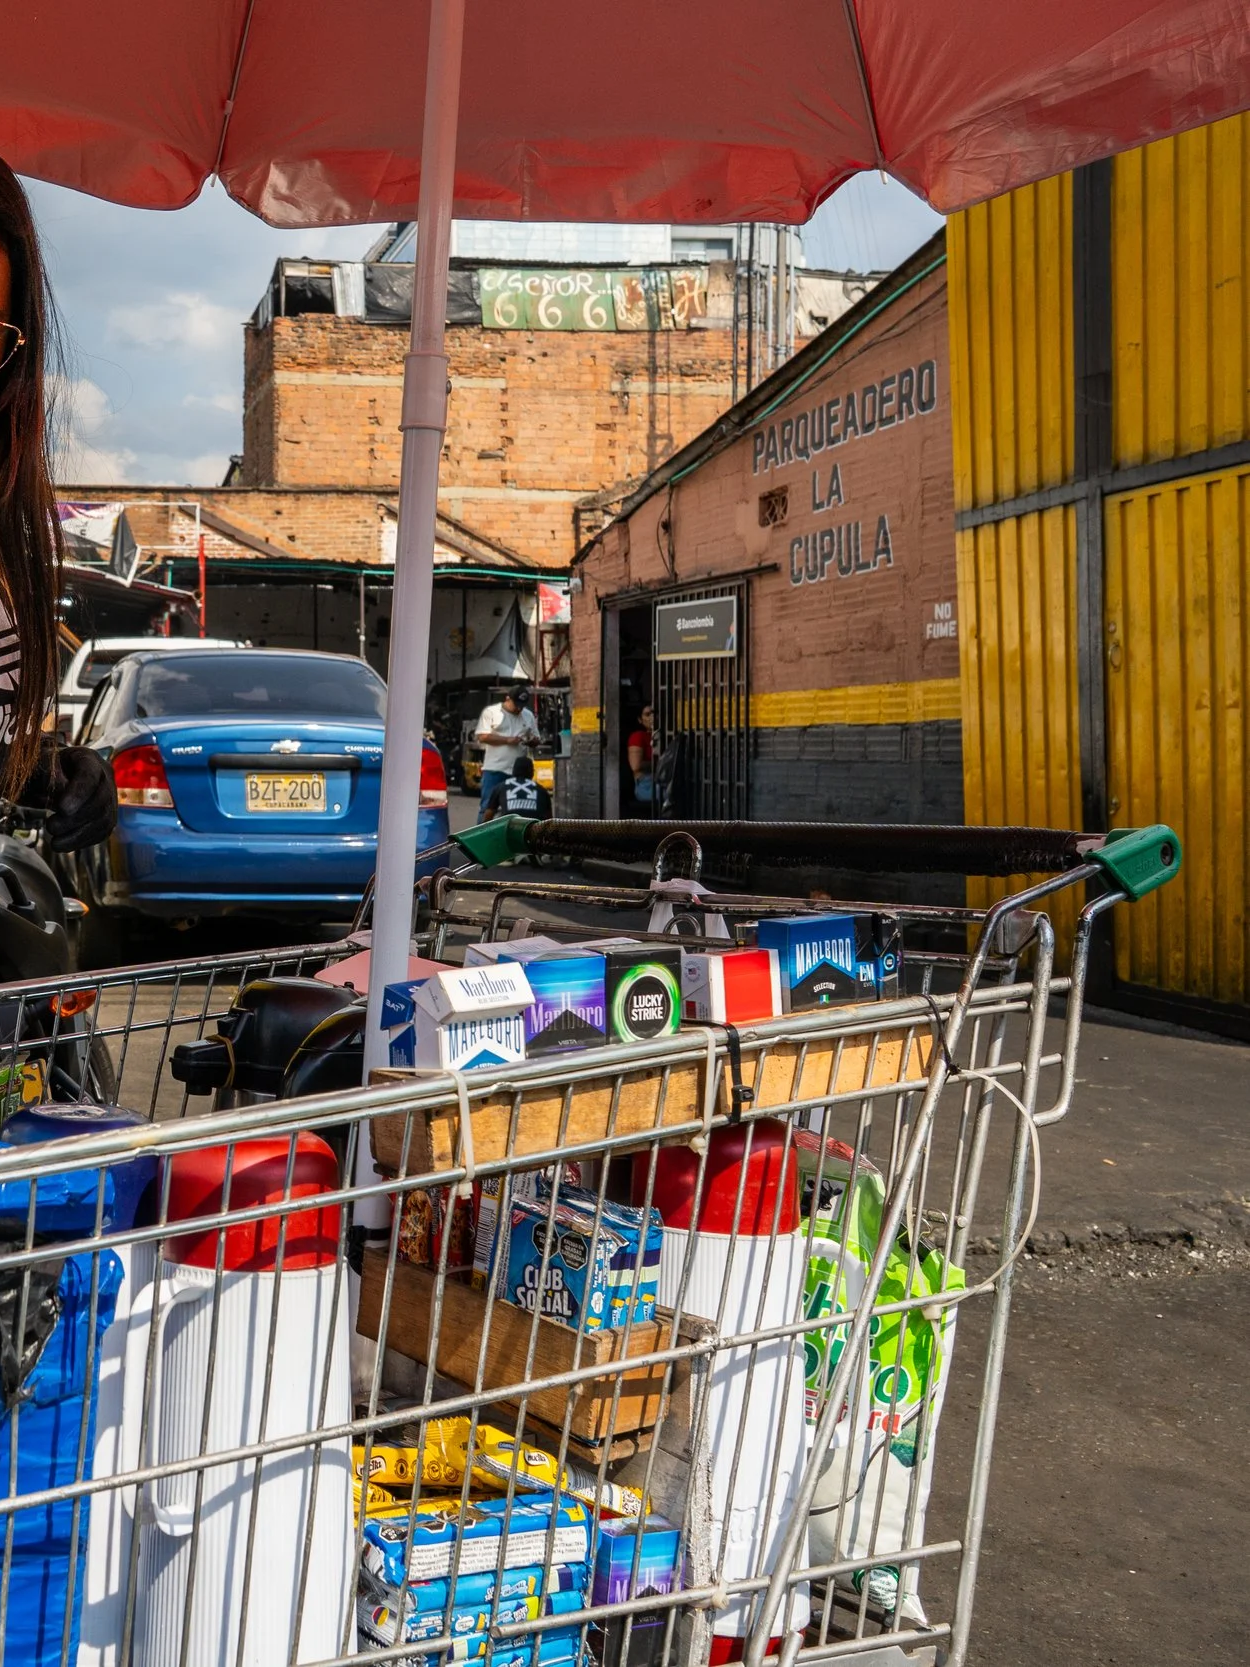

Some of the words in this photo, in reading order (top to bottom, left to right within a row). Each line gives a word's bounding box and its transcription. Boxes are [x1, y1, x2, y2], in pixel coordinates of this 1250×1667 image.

[752, 358, 938, 476] PARQUEADERO
[812, 462, 845, 515] LA
[789, 514, 894, 587] CUPULA
[934, 602, 952, 620] NO
[926, 620, 957, 640] FUME
[344, 745, 383, 754] CHEVROL
[795, 937, 852, 979] MARLBORO
[459, 970, 517, 998] Marlboro
[813, 982, 836, 993] SELECTION
[385, 998, 401, 1012] BAT
[530, 991, 603, 1034] Marlboro
[632, 993, 664, 1009] LUCKY
[631, 1007, 664, 1021] STRIKE
[448, 1015, 522, 1063] MARLBORO
